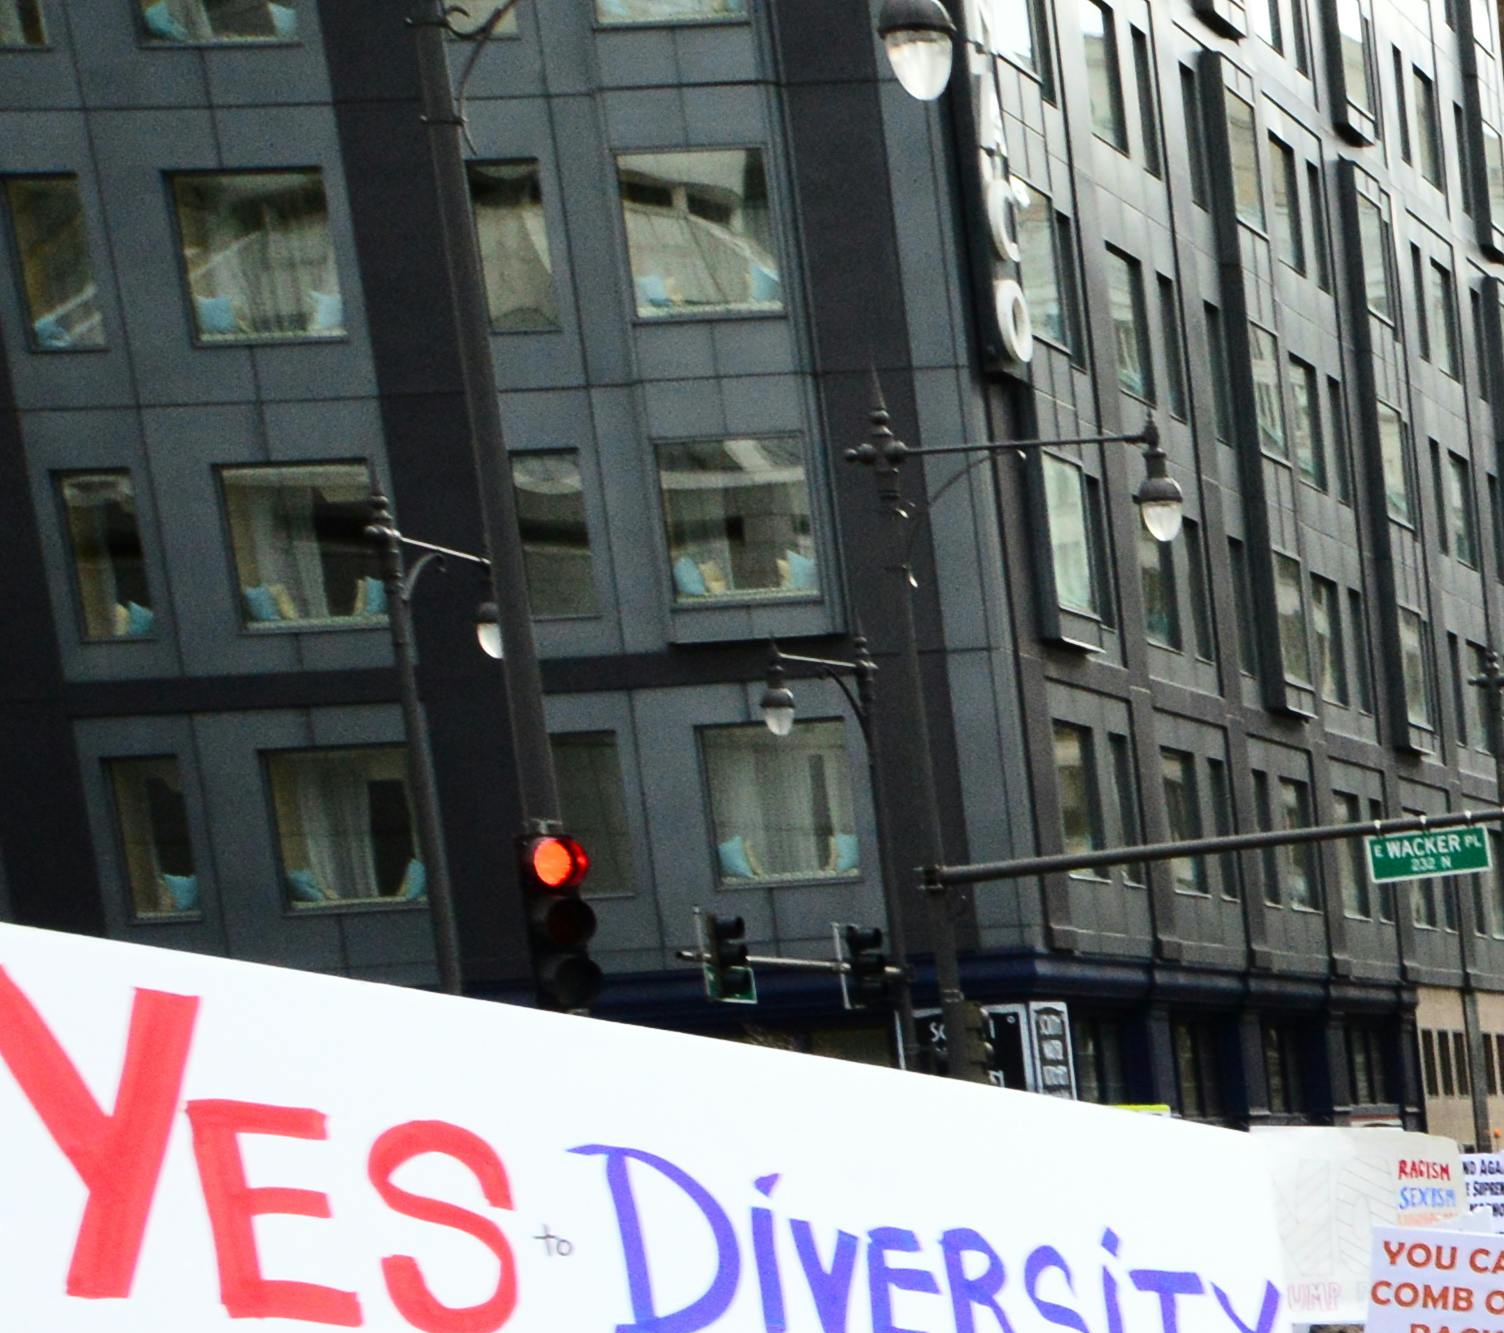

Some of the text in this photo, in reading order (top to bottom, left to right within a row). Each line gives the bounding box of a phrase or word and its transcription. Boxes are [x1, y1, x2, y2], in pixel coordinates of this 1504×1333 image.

[1387, 834, 1482, 859] WACKER PL
[1411, 857, 1437, 870] 232
[1398, 1160, 1450, 1180] RACISM
[1399, 1187, 1456, 1210] SEXISM
[533, 1225, 572, 1258] to
[1383, 1241, 1457, 1270] YOU
[1370, 1281, 1473, 1312] COMB
